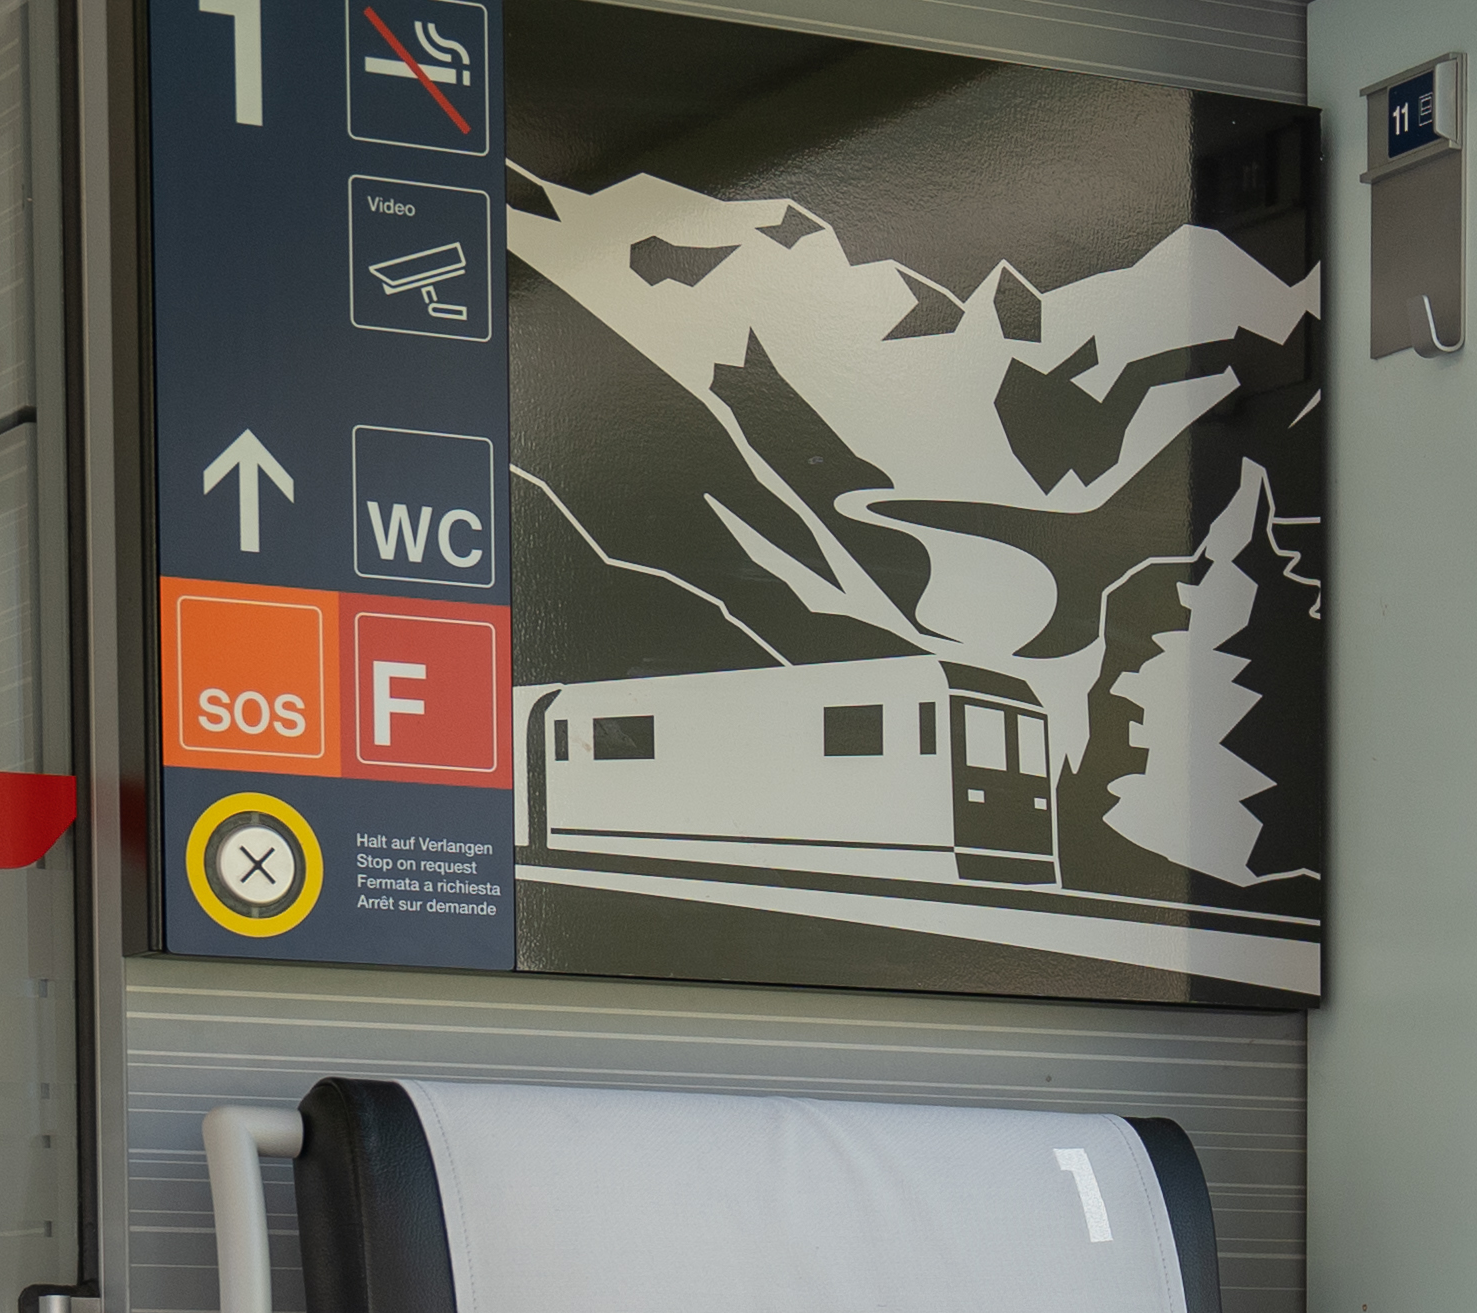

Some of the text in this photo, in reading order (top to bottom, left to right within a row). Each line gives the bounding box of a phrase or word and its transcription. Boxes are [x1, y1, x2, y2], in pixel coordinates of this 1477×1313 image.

[199, 0, 263, 126] 1
[1392, 101, 1409, 136] 11
[367, 195, 416, 217] Video
[366, 500, 484, 568] WC
[197, 687, 306, 738] SOS
[372, 659, 427, 747] F
[356, 832, 492, 856] Halt auf Verlangen
[356, 853, 477, 875] Stop on request
[357, 875, 501, 895] Fermata a richiesta
[357, 895, 496, 915] Arrêt sur demande
[1053, 1147, 1113, 1242] 1
